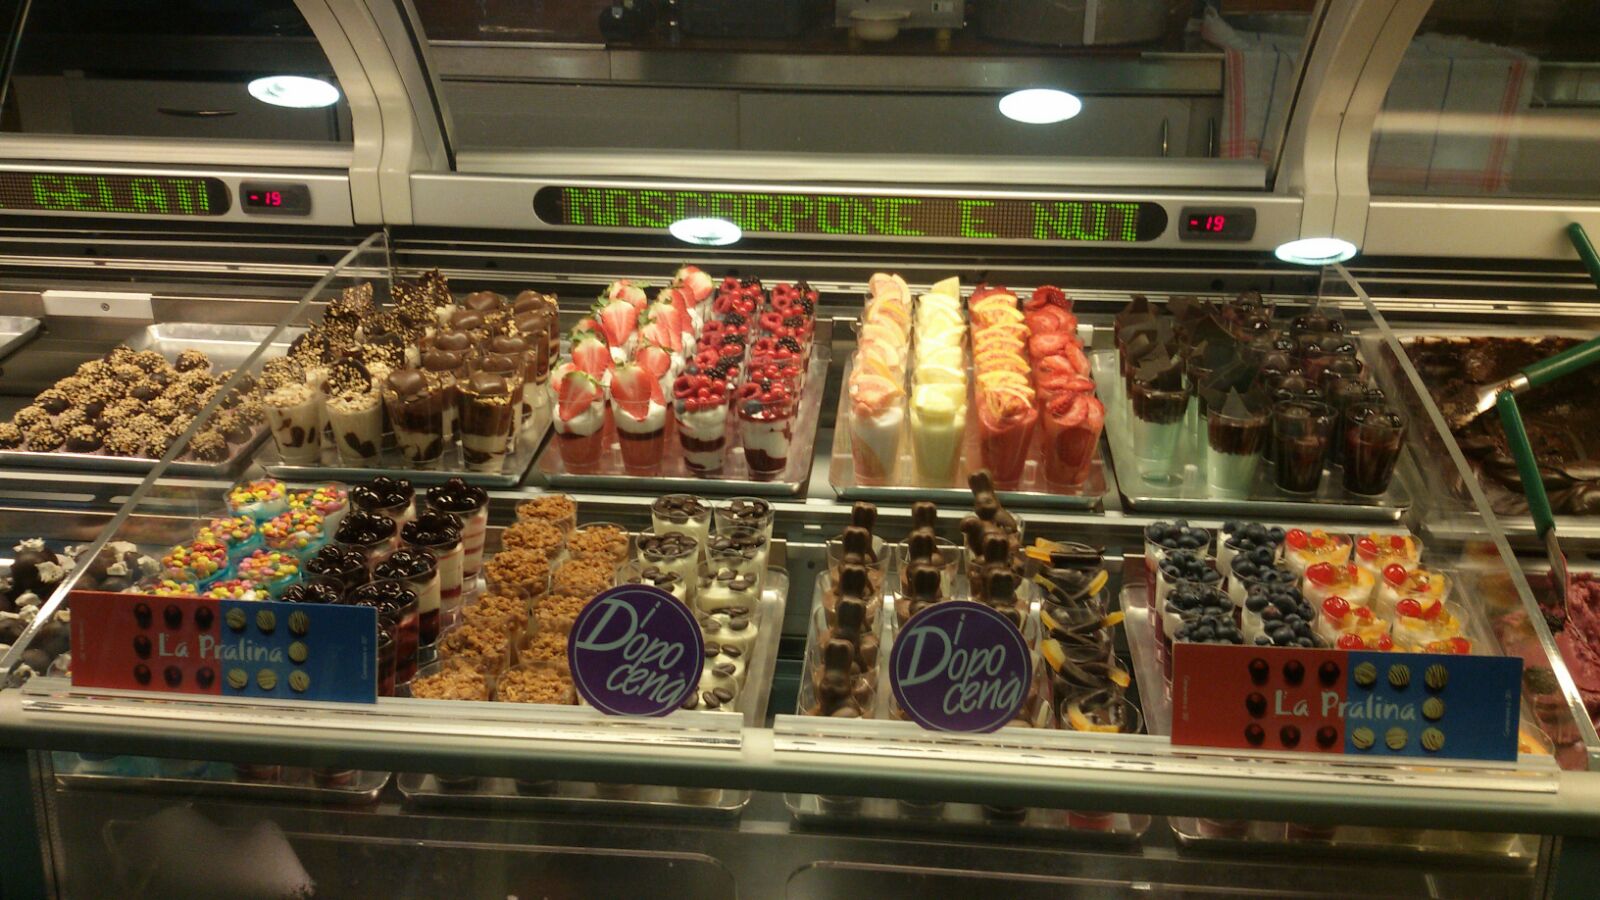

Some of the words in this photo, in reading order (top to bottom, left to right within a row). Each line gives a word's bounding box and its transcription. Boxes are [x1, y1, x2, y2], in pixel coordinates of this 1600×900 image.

[32, 174, 209, 214] GELATI
[564, 187, 926, 237] MASCARPONE
[958, 199, 998, 239] E
[1031, 201, 1139, 241] NUT
[157, 632, 189, 659] La
[199, 634, 283, 664] Pralina
[1274, 689, 1309, 718] La
[1320, 690, 1417, 723] Pralina
